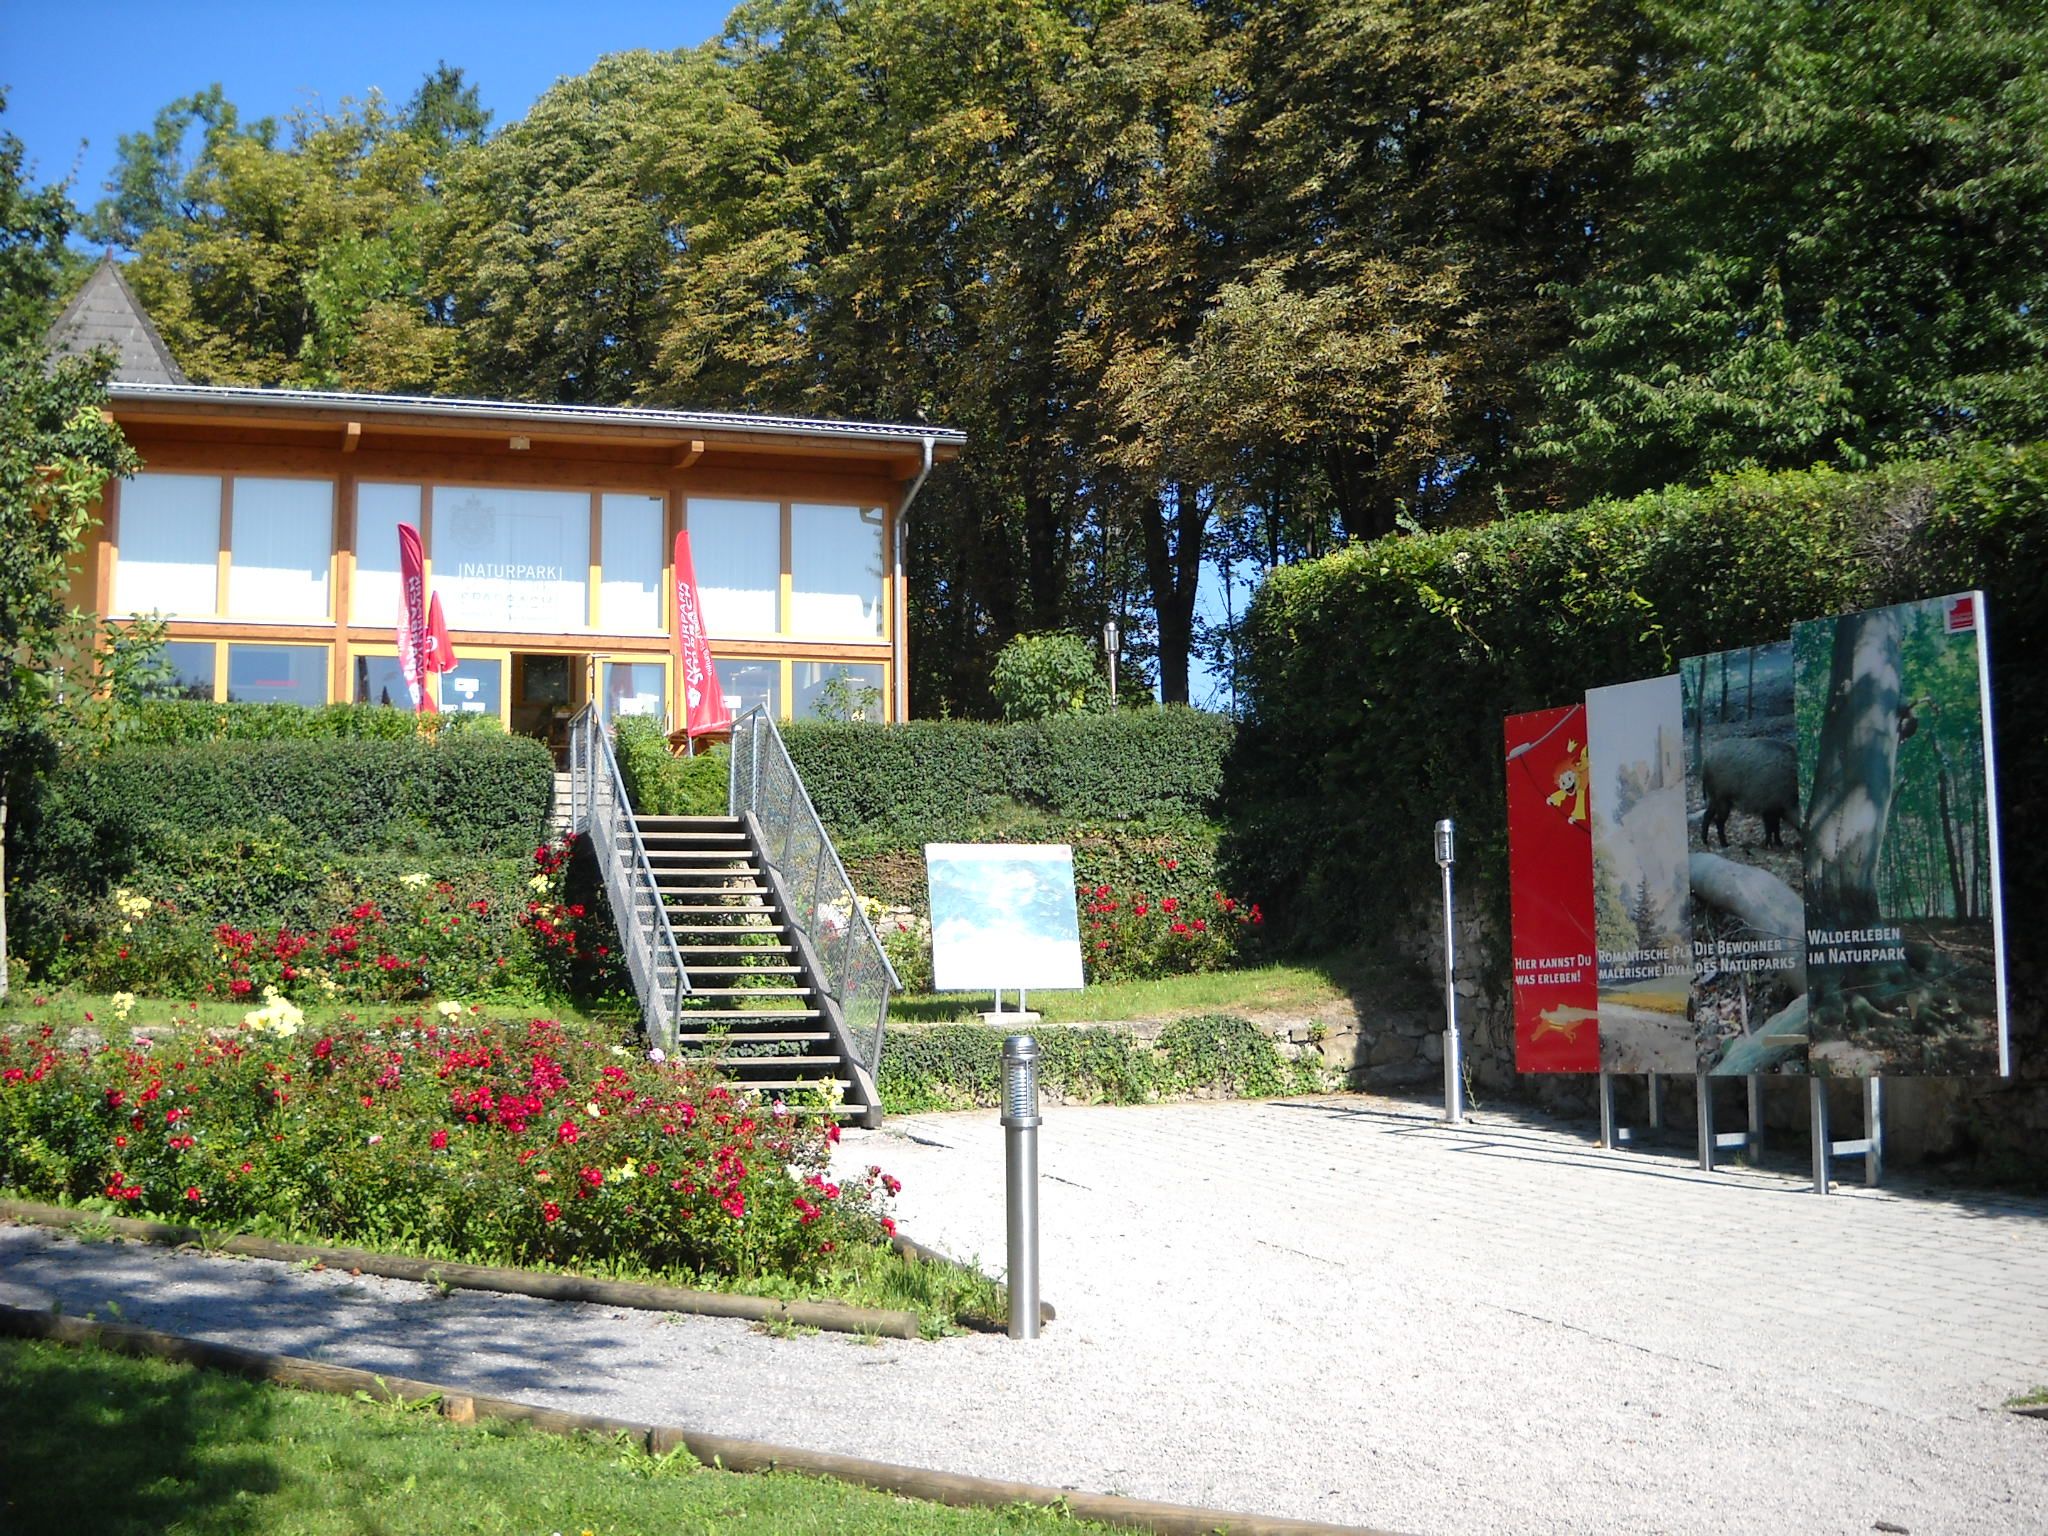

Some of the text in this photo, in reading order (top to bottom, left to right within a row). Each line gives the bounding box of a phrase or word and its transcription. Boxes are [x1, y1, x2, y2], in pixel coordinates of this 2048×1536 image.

[1515, 953, 1593, 971] HIER KANNST DU
[1828, 947, 1906, 963] NATURPARK
[1720, 956, 1796, 972] NATURPARKS
[1515, 974, 1536, 986] WAS
